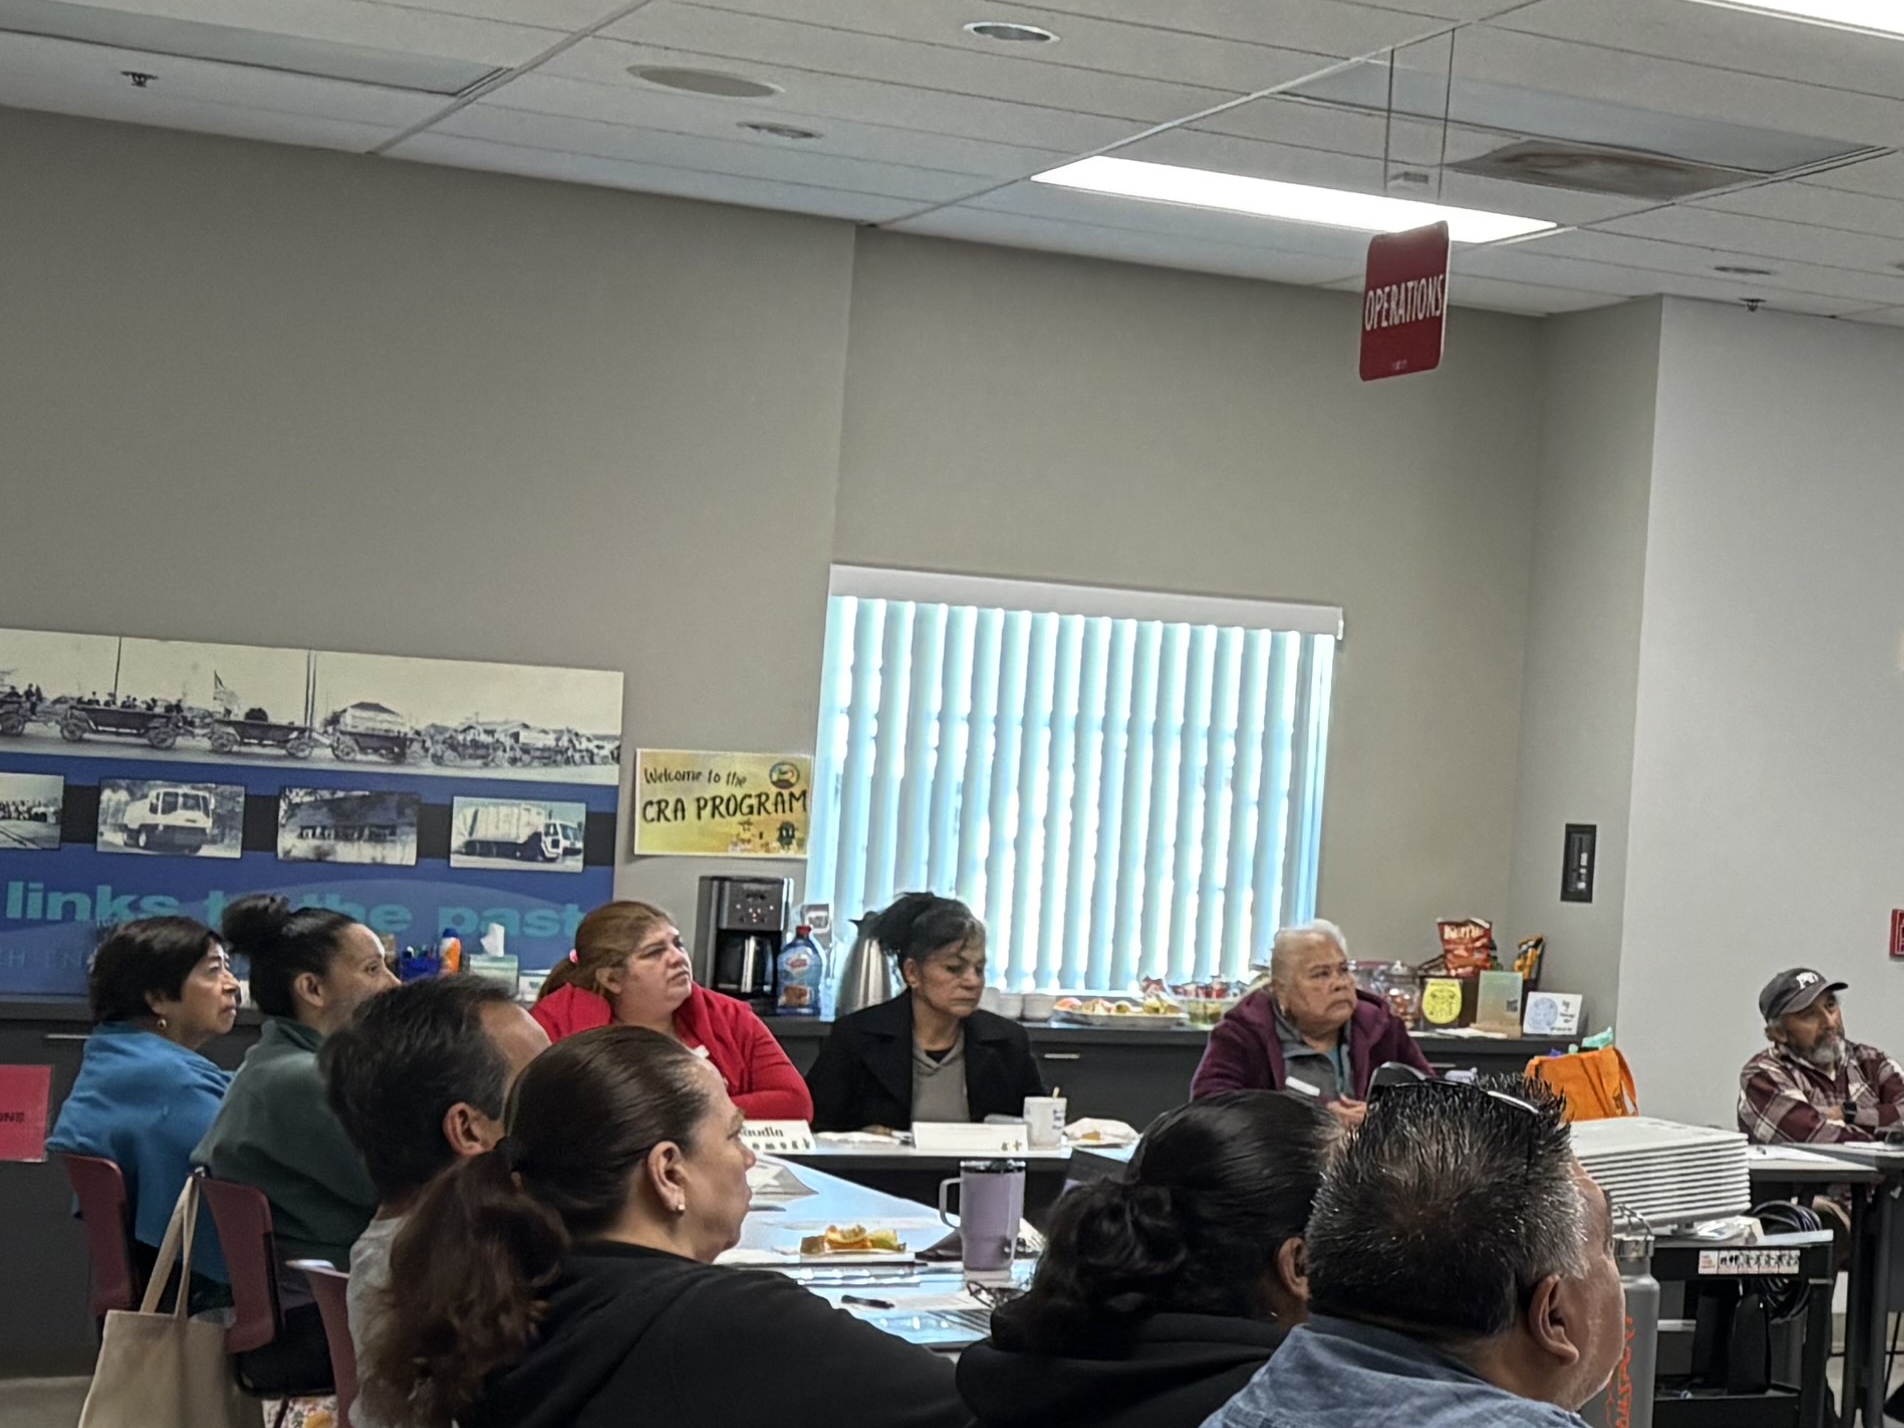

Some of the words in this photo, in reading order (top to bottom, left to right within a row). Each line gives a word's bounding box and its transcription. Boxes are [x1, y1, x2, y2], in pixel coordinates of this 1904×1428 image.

[1364, 273, 1444, 332] OPERATIONS
[643, 767, 702, 785] Welcome
[707, 769, 721, 784] to
[725, 771, 748, 788] the
[642, 797, 687, 823] CRA
[695, 789, 808, 821] PROGRAM
[6, 881, 180, 924] links
